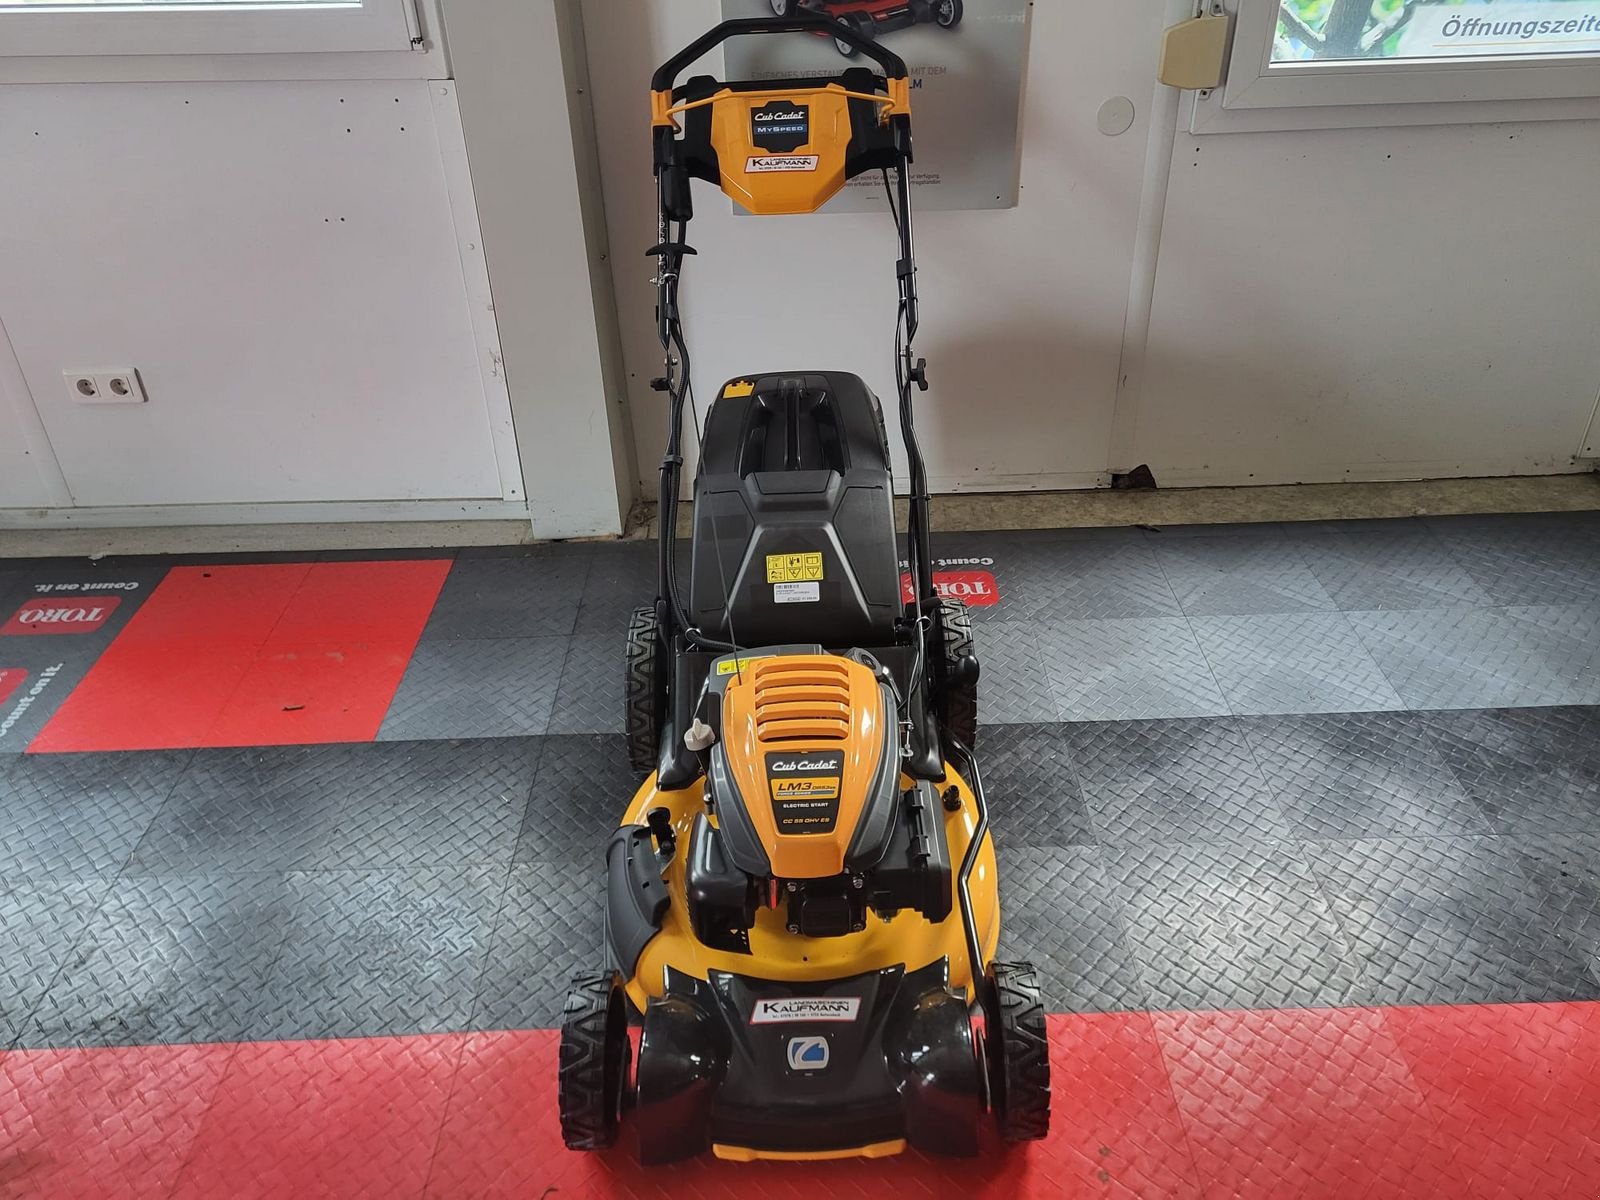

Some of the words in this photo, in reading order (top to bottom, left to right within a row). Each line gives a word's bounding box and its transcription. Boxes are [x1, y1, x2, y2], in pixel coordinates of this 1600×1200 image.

[911, 67, 926, 76] MIT
[927, 66, 947, 75] DEM
[754, 112, 774, 121] Cub
[774, 111, 805, 120] Cadet
[752, 158, 812, 167] KAUFMANN
[938, 557, 994, 566] Count
[34, 583, 54, 593] it.
[55, 583, 80, 591] on
[81, 581, 140, 591] Count
[19, 607, 105, 624] TORO
[30, 678, 51, 695] on
[772, 760, 797, 771] Cub
[797, 759, 837, 770] Cadet
[778, 782, 813, 791] LM3
[763, 1002, 850, 1013] KAUFMANN
